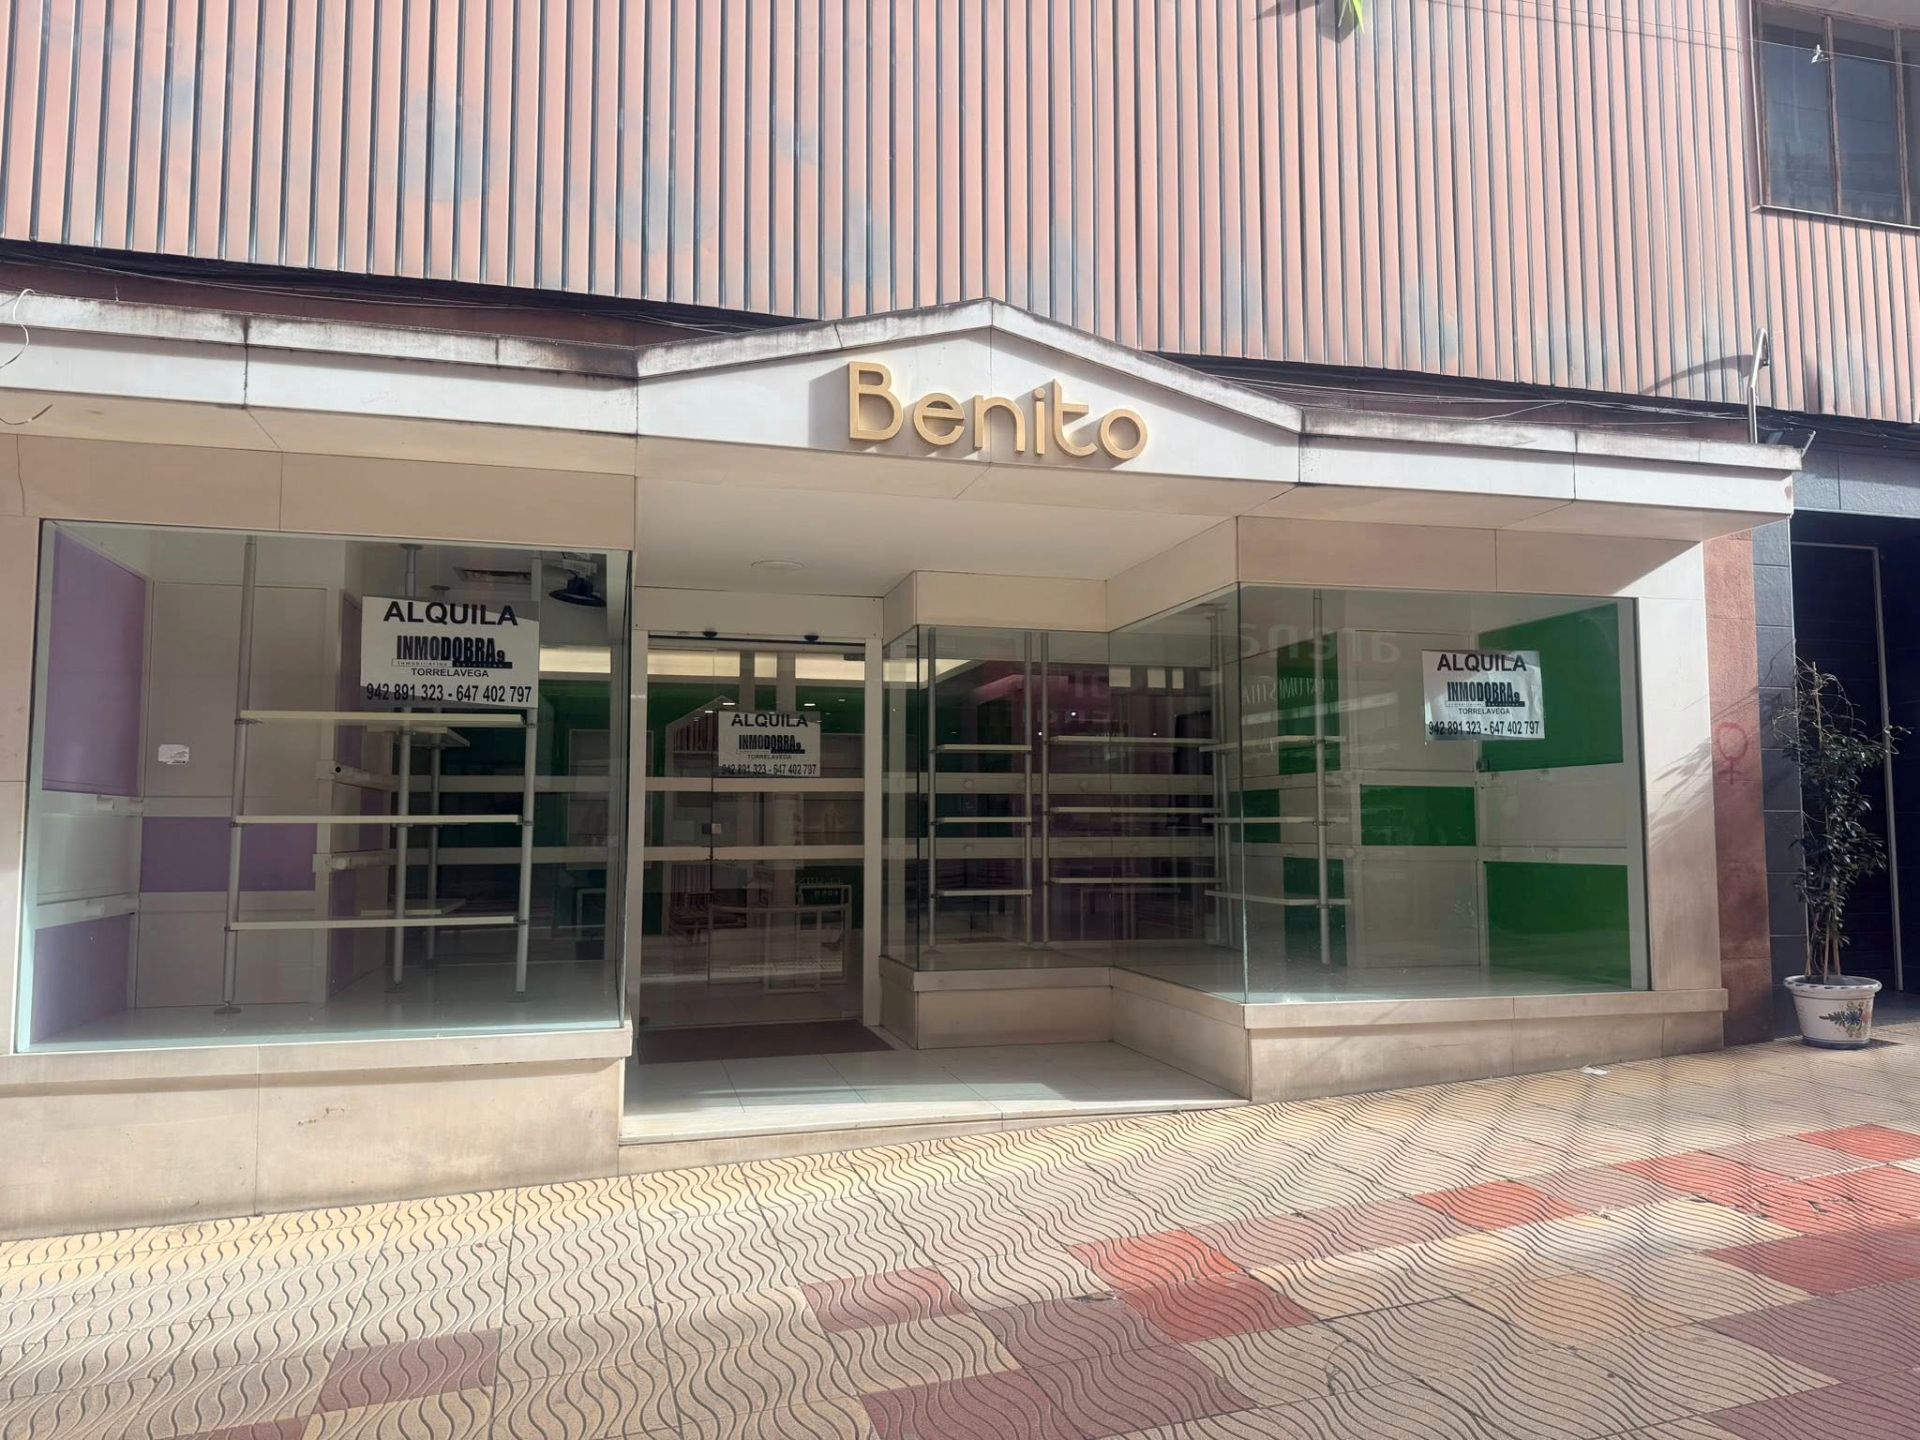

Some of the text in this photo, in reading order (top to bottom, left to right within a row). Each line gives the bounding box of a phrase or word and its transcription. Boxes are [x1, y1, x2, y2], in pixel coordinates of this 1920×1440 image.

[849, 361, 1148, 459] Benito
[383, 601, 518, 626] ALQUILA
[1437, 654, 1527, 672] ALQUILA
[411, 668, 489, 677] TORRELAVEGA
[366, 683, 389, 700] 942
[394, 684, 415, 700] 891
[421, 684, 444, 701] 323
[456, 685, 479, 701] 647
[483, 686, 505, 702] 402
[509, 686, 532, 703] 797
[731, 713, 808, 728] ALQUILA
[1428, 721, 1445, 735] 942
[1447, 721, 1463, 735] 891
[1466, 721, 1481, 734] 323
[1489, 721, 1504, 734] 647
[1508, 721, 1522, 734] 402
[1525, 721, 1540, 734] 797
[753, 764, 767, 775] 323
[788, 764, 801, 775] 402
